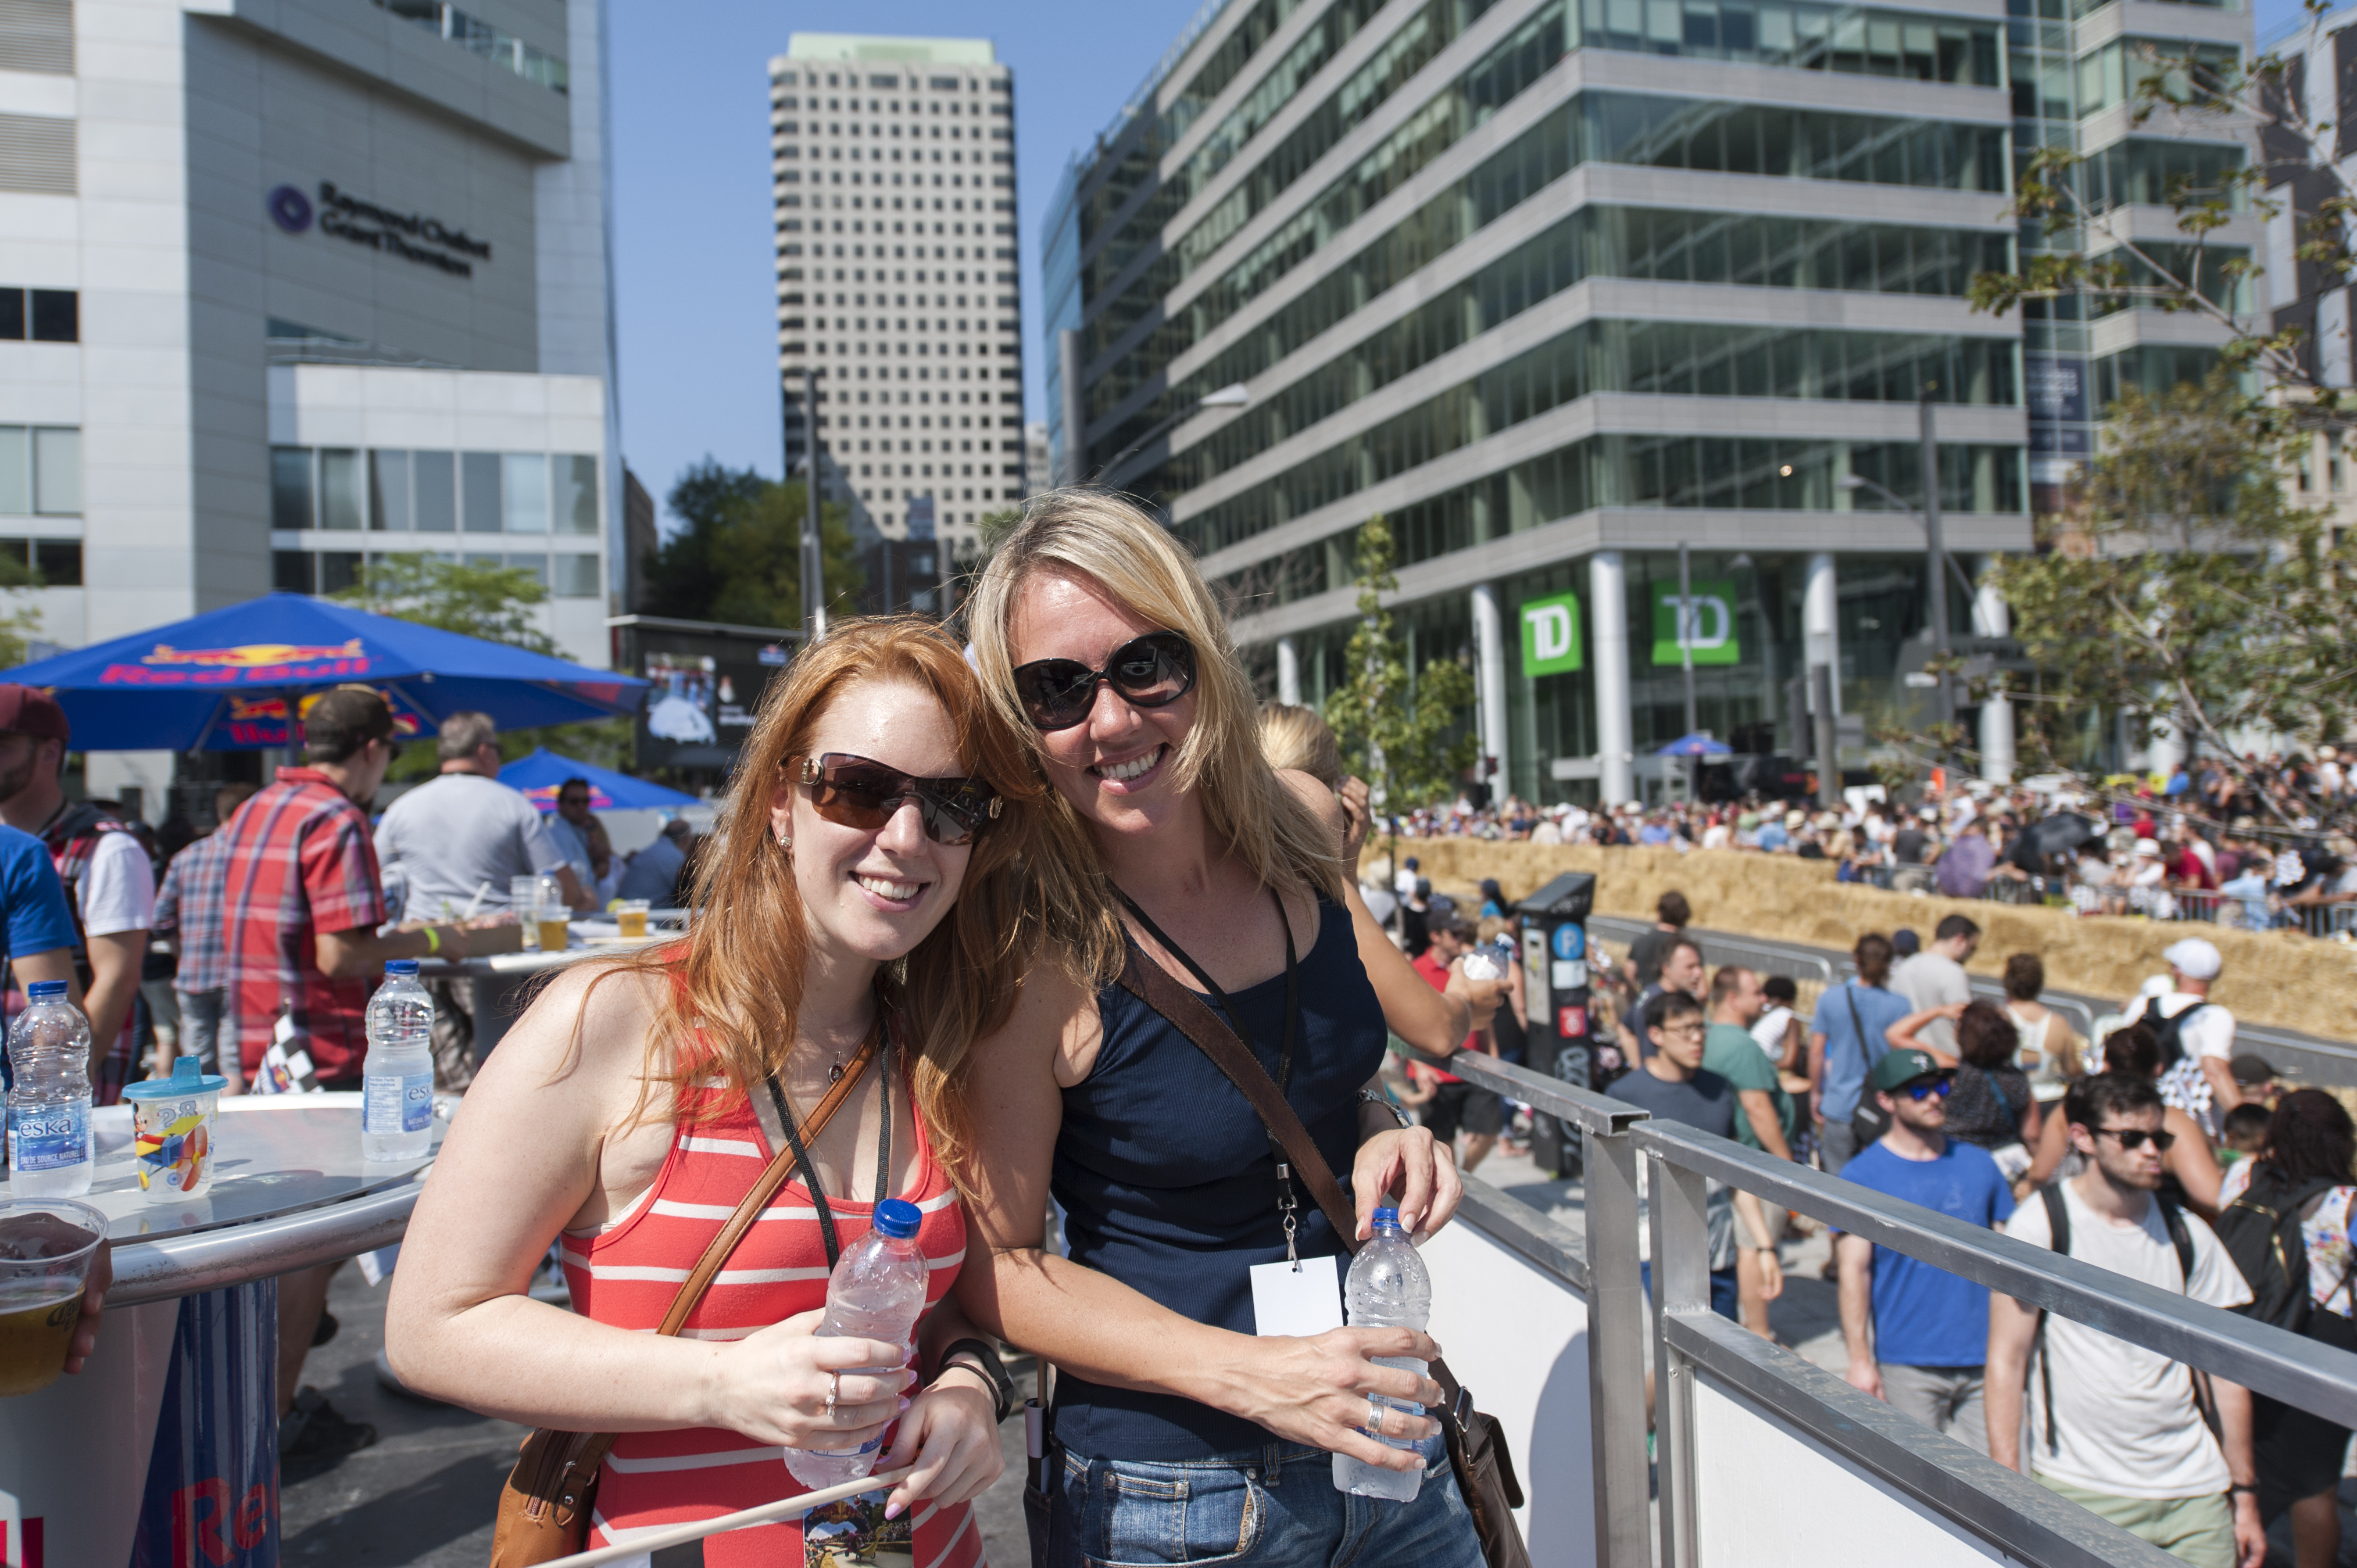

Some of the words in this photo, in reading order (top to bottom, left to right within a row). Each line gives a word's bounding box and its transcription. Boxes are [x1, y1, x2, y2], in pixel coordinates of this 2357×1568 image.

[1525, 604, 1572, 661] TD
[1661, 595, 1730, 649] TD
[99, 664, 238, 685] Red
[246, 657, 370, 681] Bull
[409, 1085, 432, 1101] esk
[20, 1118, 71, 1137] eska
[30, 1155, 37, 1164] DE
[37, 1153, 58, 1164] SOURCE
[59, 1148, 84, 1160] NATURELLE
